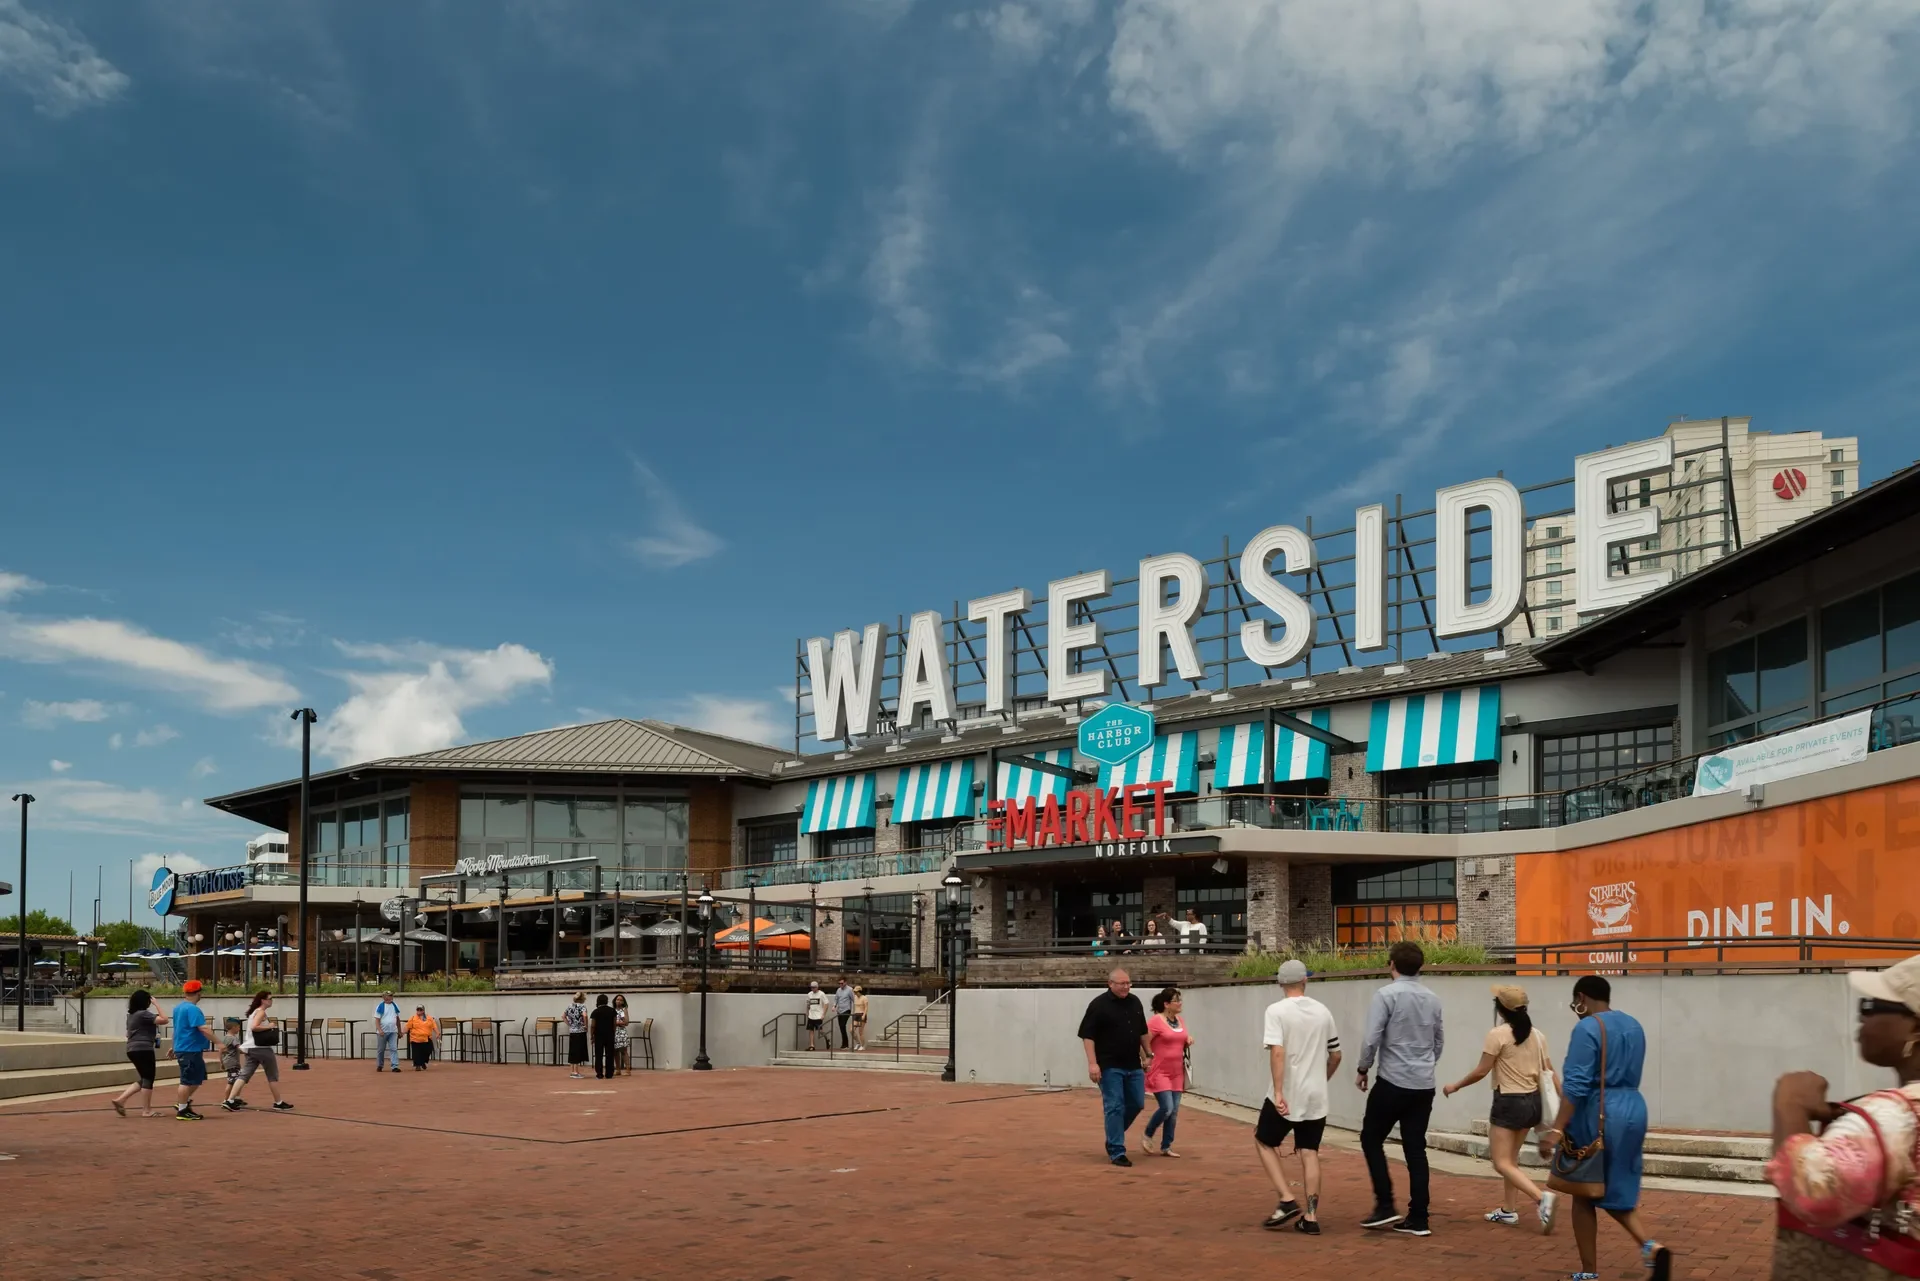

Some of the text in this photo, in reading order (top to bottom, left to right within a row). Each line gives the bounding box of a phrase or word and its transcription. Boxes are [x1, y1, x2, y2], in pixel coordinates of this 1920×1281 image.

[806, 435, 1675, 742] WATERSIDE
[1087, 726, 1142, 741] HARBOR
[1105, 719, 1123, 727] THE
[1097, 737, 1132, 749] CLUB
[1735, 749, 1776, 768] AVAILABLE
[1776, 745, 1793, 757] FOR
[1794, 736, 1828, 752] PRIVATE
[1829, 727, 1863, 744] EVENTS
[1005, 780, 1174, 849] MARKET
[1095, 840, 1172, 858] NORFOLK
[185, 871, 244, 895] TAPHOUSE
[1589, 880, 1638, 904] STRIPERS
[1687, 894, 1850, 946] DINE IN.
[1588, 951, 1638, 965] COMIG
